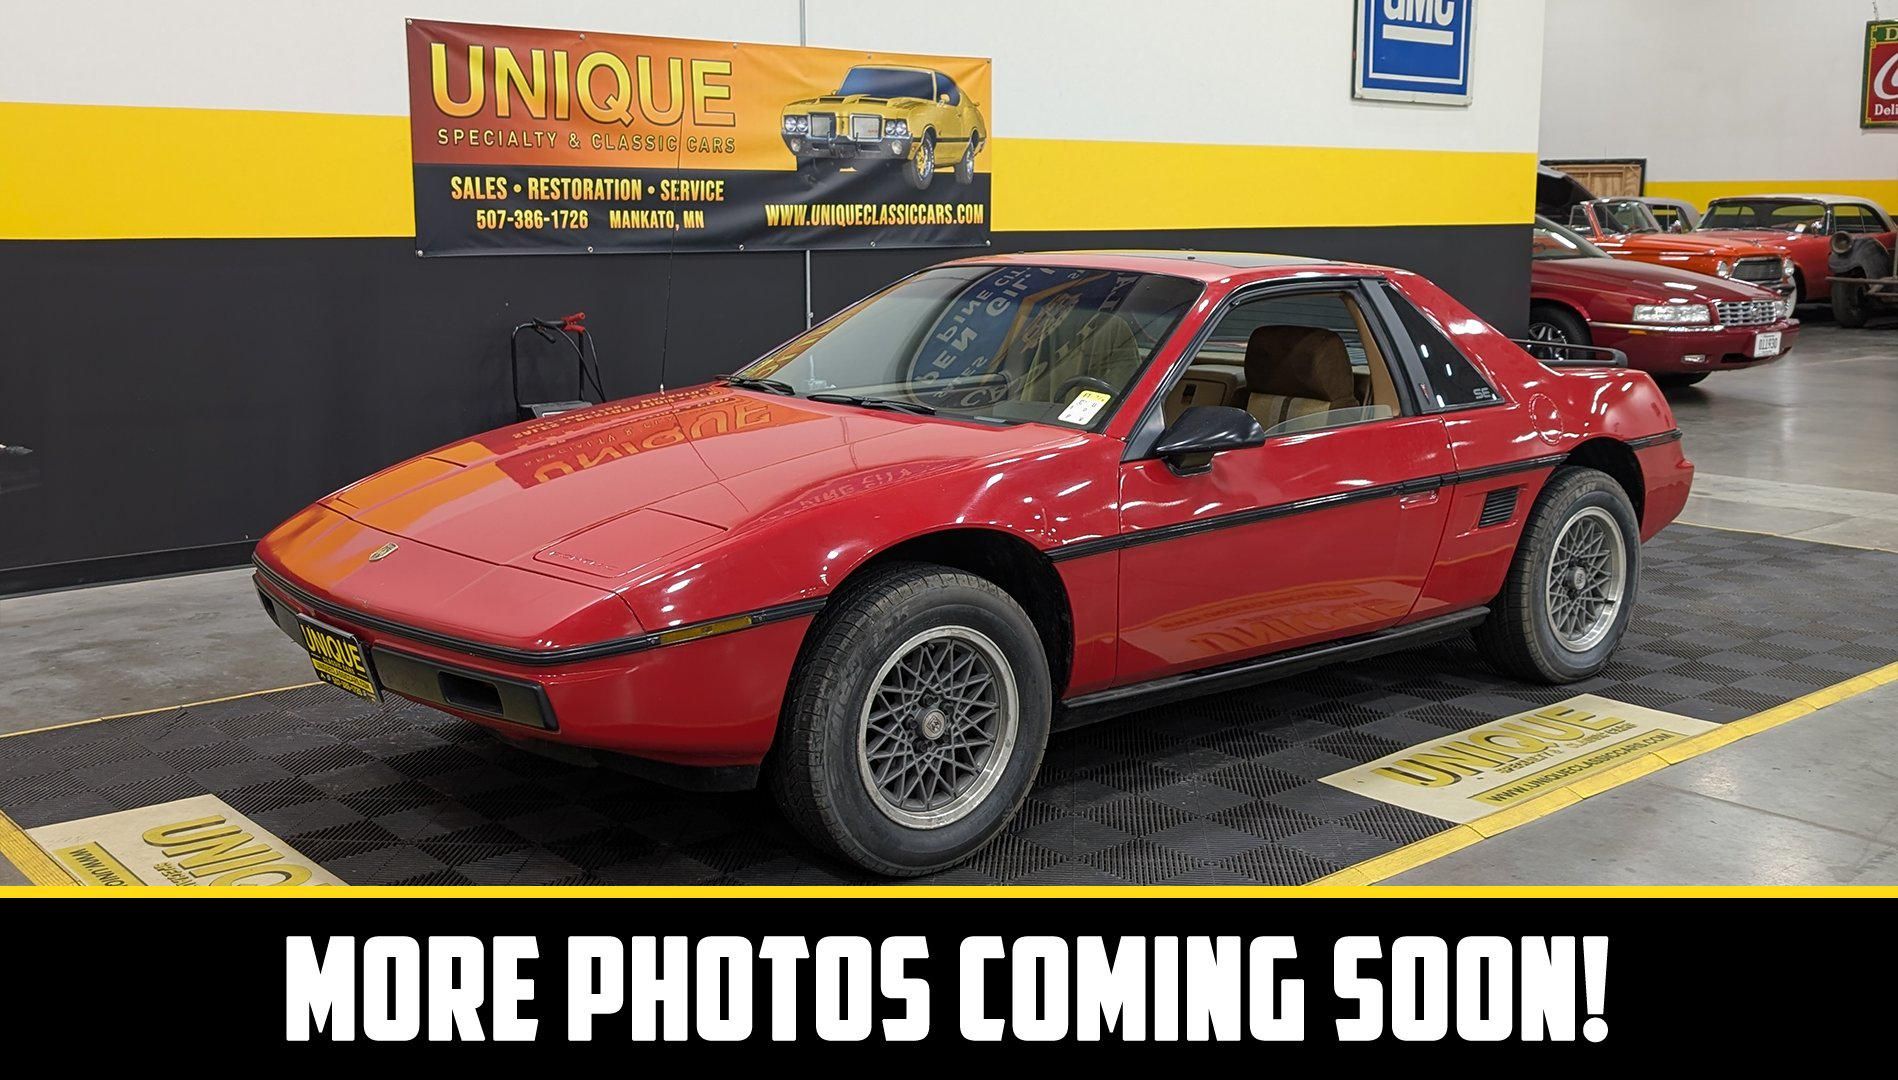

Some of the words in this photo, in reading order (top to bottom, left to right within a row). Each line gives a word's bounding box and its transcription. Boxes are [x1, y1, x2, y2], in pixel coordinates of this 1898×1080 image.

[431, 42, 735, 127] UNIQUE
[438, 128, 558, 148] SPECIALTY
[568, 131, 581, 149] &
[592, 134, 678, 151] CLASSIC
[687, 136, 736, 153] CARS
[451, 176, 507, 200] SALES
[528, 177, 642, 201] RESTORATION
[660, 179, 724, 201] SERVICE
[476, 209, 589, 230] 507-386-1726
[609, 209, 680, 231] MANKATO,
[683, 210, 705, 229] MN
[765, 204, 984, 227] WWW.UNIQUECLASSICCARS.COM
[1473, 387, 1491, 399] SE
[300, 624, 366, 673] UNIQUE
[1371, 705, 1626, 788] UNIQUE
